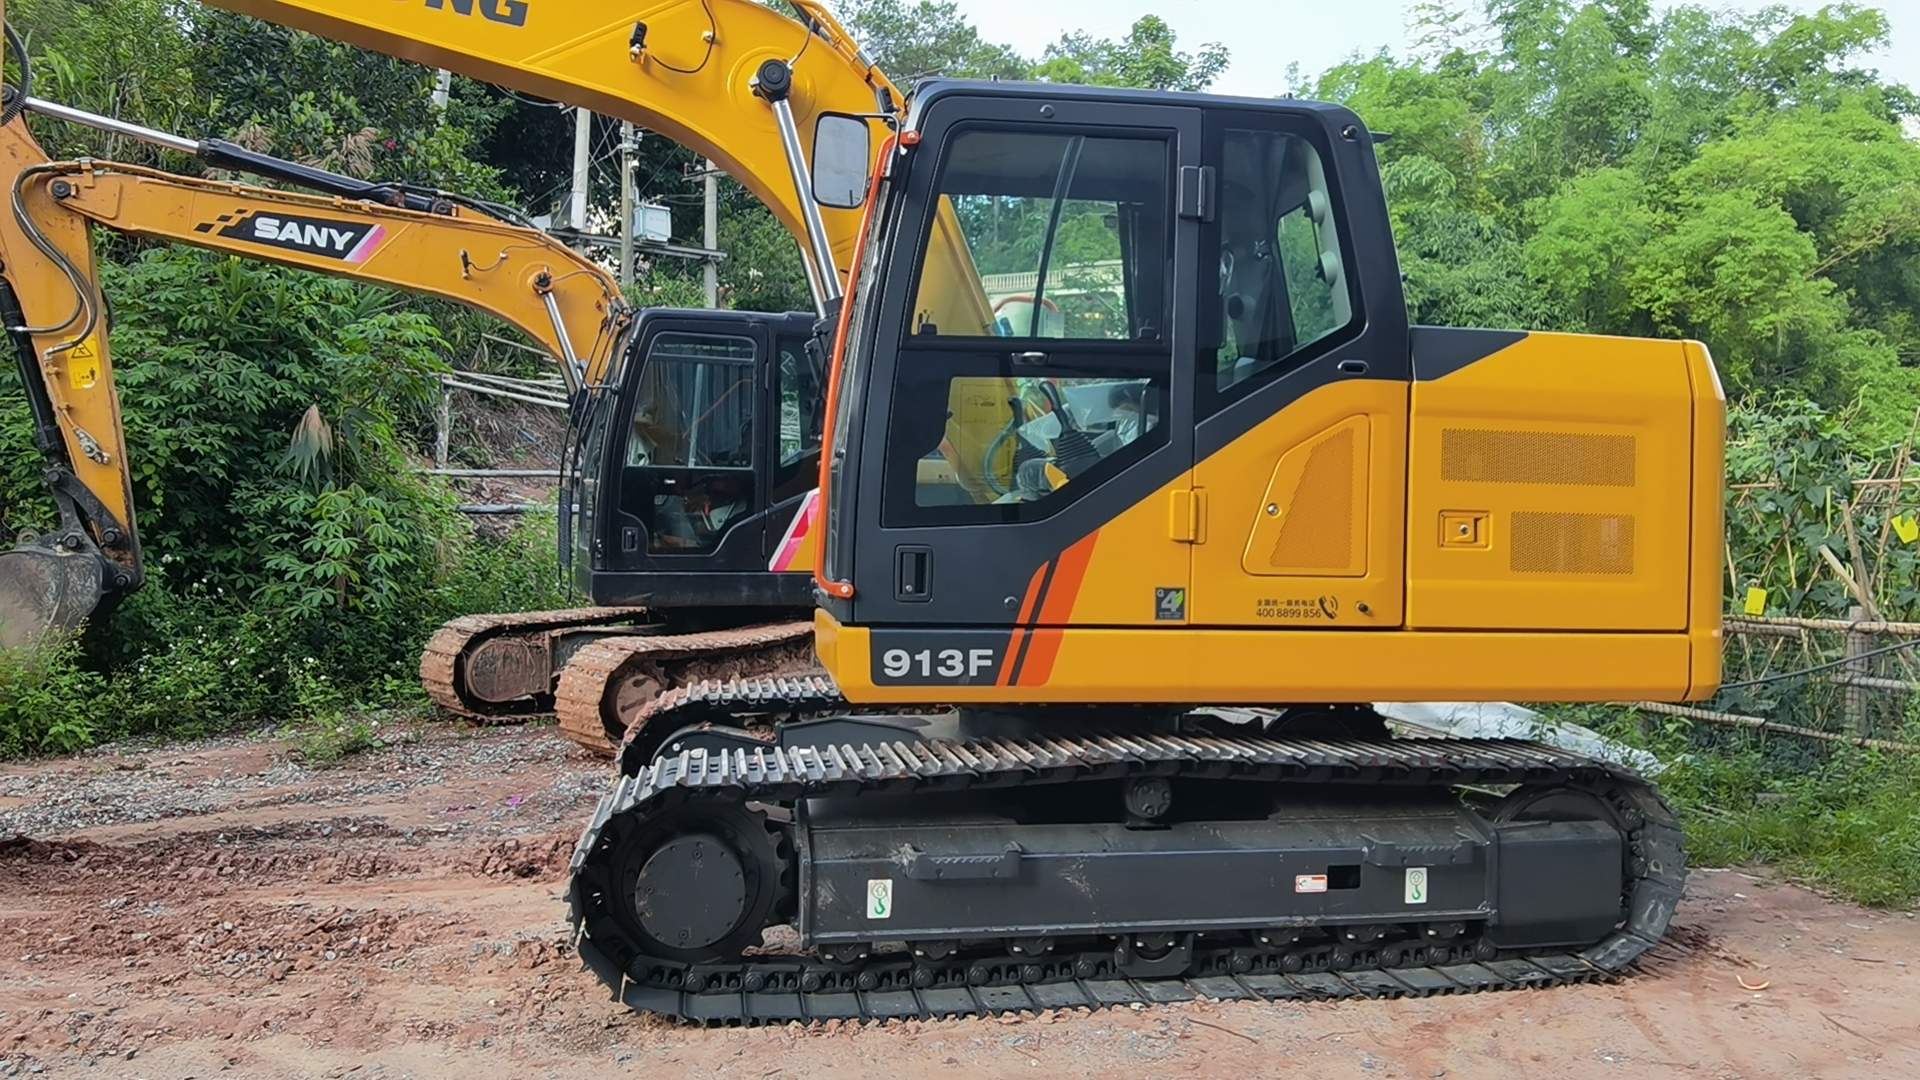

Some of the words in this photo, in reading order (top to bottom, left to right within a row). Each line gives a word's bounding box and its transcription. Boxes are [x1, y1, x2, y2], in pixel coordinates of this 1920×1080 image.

[254, 216, 354, 251] SANY
[1256, 608, 1275, 618] 400
[883, 648, 994, 678] 913F
